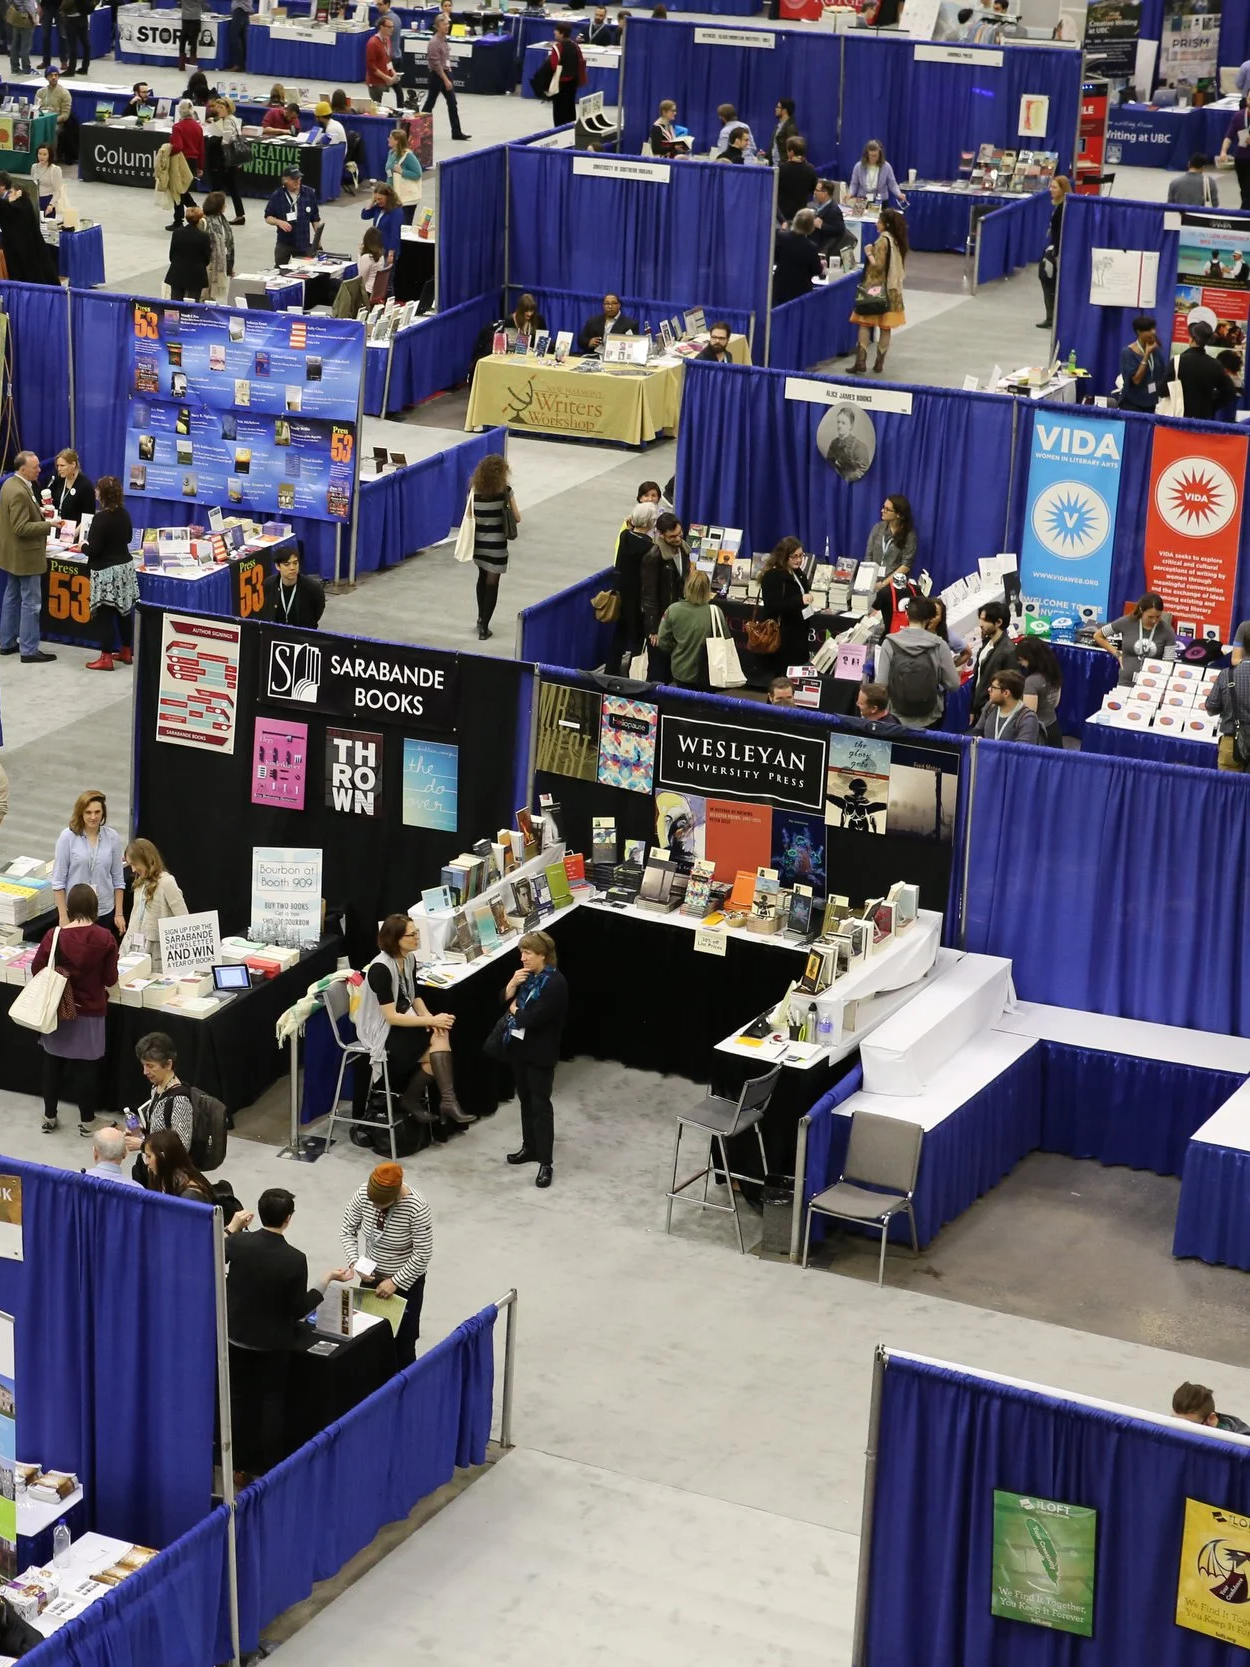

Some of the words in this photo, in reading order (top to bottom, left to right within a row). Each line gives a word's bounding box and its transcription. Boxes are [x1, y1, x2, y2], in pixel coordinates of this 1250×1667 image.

[1172, 38, 1210, 48] PRISM
[252, 143, 302, 162] REATIVE
[135, 303, 151, 312] Press
[134, 310, 159, 340] 53
[534, 391, 602, 417] Writers
[826, 390, 838, 399] ALICE
[839, 391, 854, 401] JAMES
[855, 394, 872, 403] BOOKS
[333, 425, 349, 435] Press
[528, 410, 594, 433] Workshop
[331, 433, 353, 463] 53
[1036, 424, 1120, 460] VIDA
[1035, 452, 1060, 461] WOMEN
[1069, 455, 1100, 466] LITERARY
[1101, 460, 1119, 469] ARTS
[1184, 493, 1208, 503] VIDA
[50, 560, 79, 575] Press
[239, 558, 257, 571] Press
[1032, 571, 1099, 586] WWW.VIDAWEB.ORG
[48, 573, 91, 624] 53
[239, 564, 264, 617] 53
[192, 627, 211, 636] AUTHOR
[212, 630, 233, 639] SIGNINGS
[330, 655, 445, 689] SARABANDE
[355, 688, 424, 716] BOOKS
[166, 729, 191, 739] SARABANDE
[191, 733, 207, 741] BOOKS
[333, 738, 376, 768] TH
[678, 734, 807, 771] WESLEYAN
[332, 763, 376, 790] RO
[677, 759, 760, 780] UNIVERSITY
[769, 772, 805, 788] PRESS
[332, 787, 375, 816] WN
[260, 864, 301, 875] Bourbon
[304, 867, 314, 876] at
[261, 877, 289, 887] Booth
[293, 878, 313, 888] 909
[264, 902, 275, 910] BUY
[277, 902, 288, 910] TWO
[290, 902, 309, 910] BOOKS
[164, 928, 179, 936] SIGN
[189, 925, 200, 933] FOR
[201, 923, 212, 931] THE
[165, 930, 213, 945] SARABANDE
[165, 938, 214, 951] eNEWSLETTER
[167, 949, 190, 962] AND
[192, 945, 214, 957] WIN
[1040, 1501, 1071, 1516] LOFT
[998, 1585, 1013, 1598] We
[1014, 1589, 1036, 1603] Find
[1037, 1593, 1044, 1605] It
[1045, 1595, 1086, 1615] Together,
[1000, 1596, 1017, 1609] You
[1018, 1599, 1041, 1616] Keep
[1042, 1604, 1050, 1615] It
[1051, 1606, 1085, 1624] Forever
